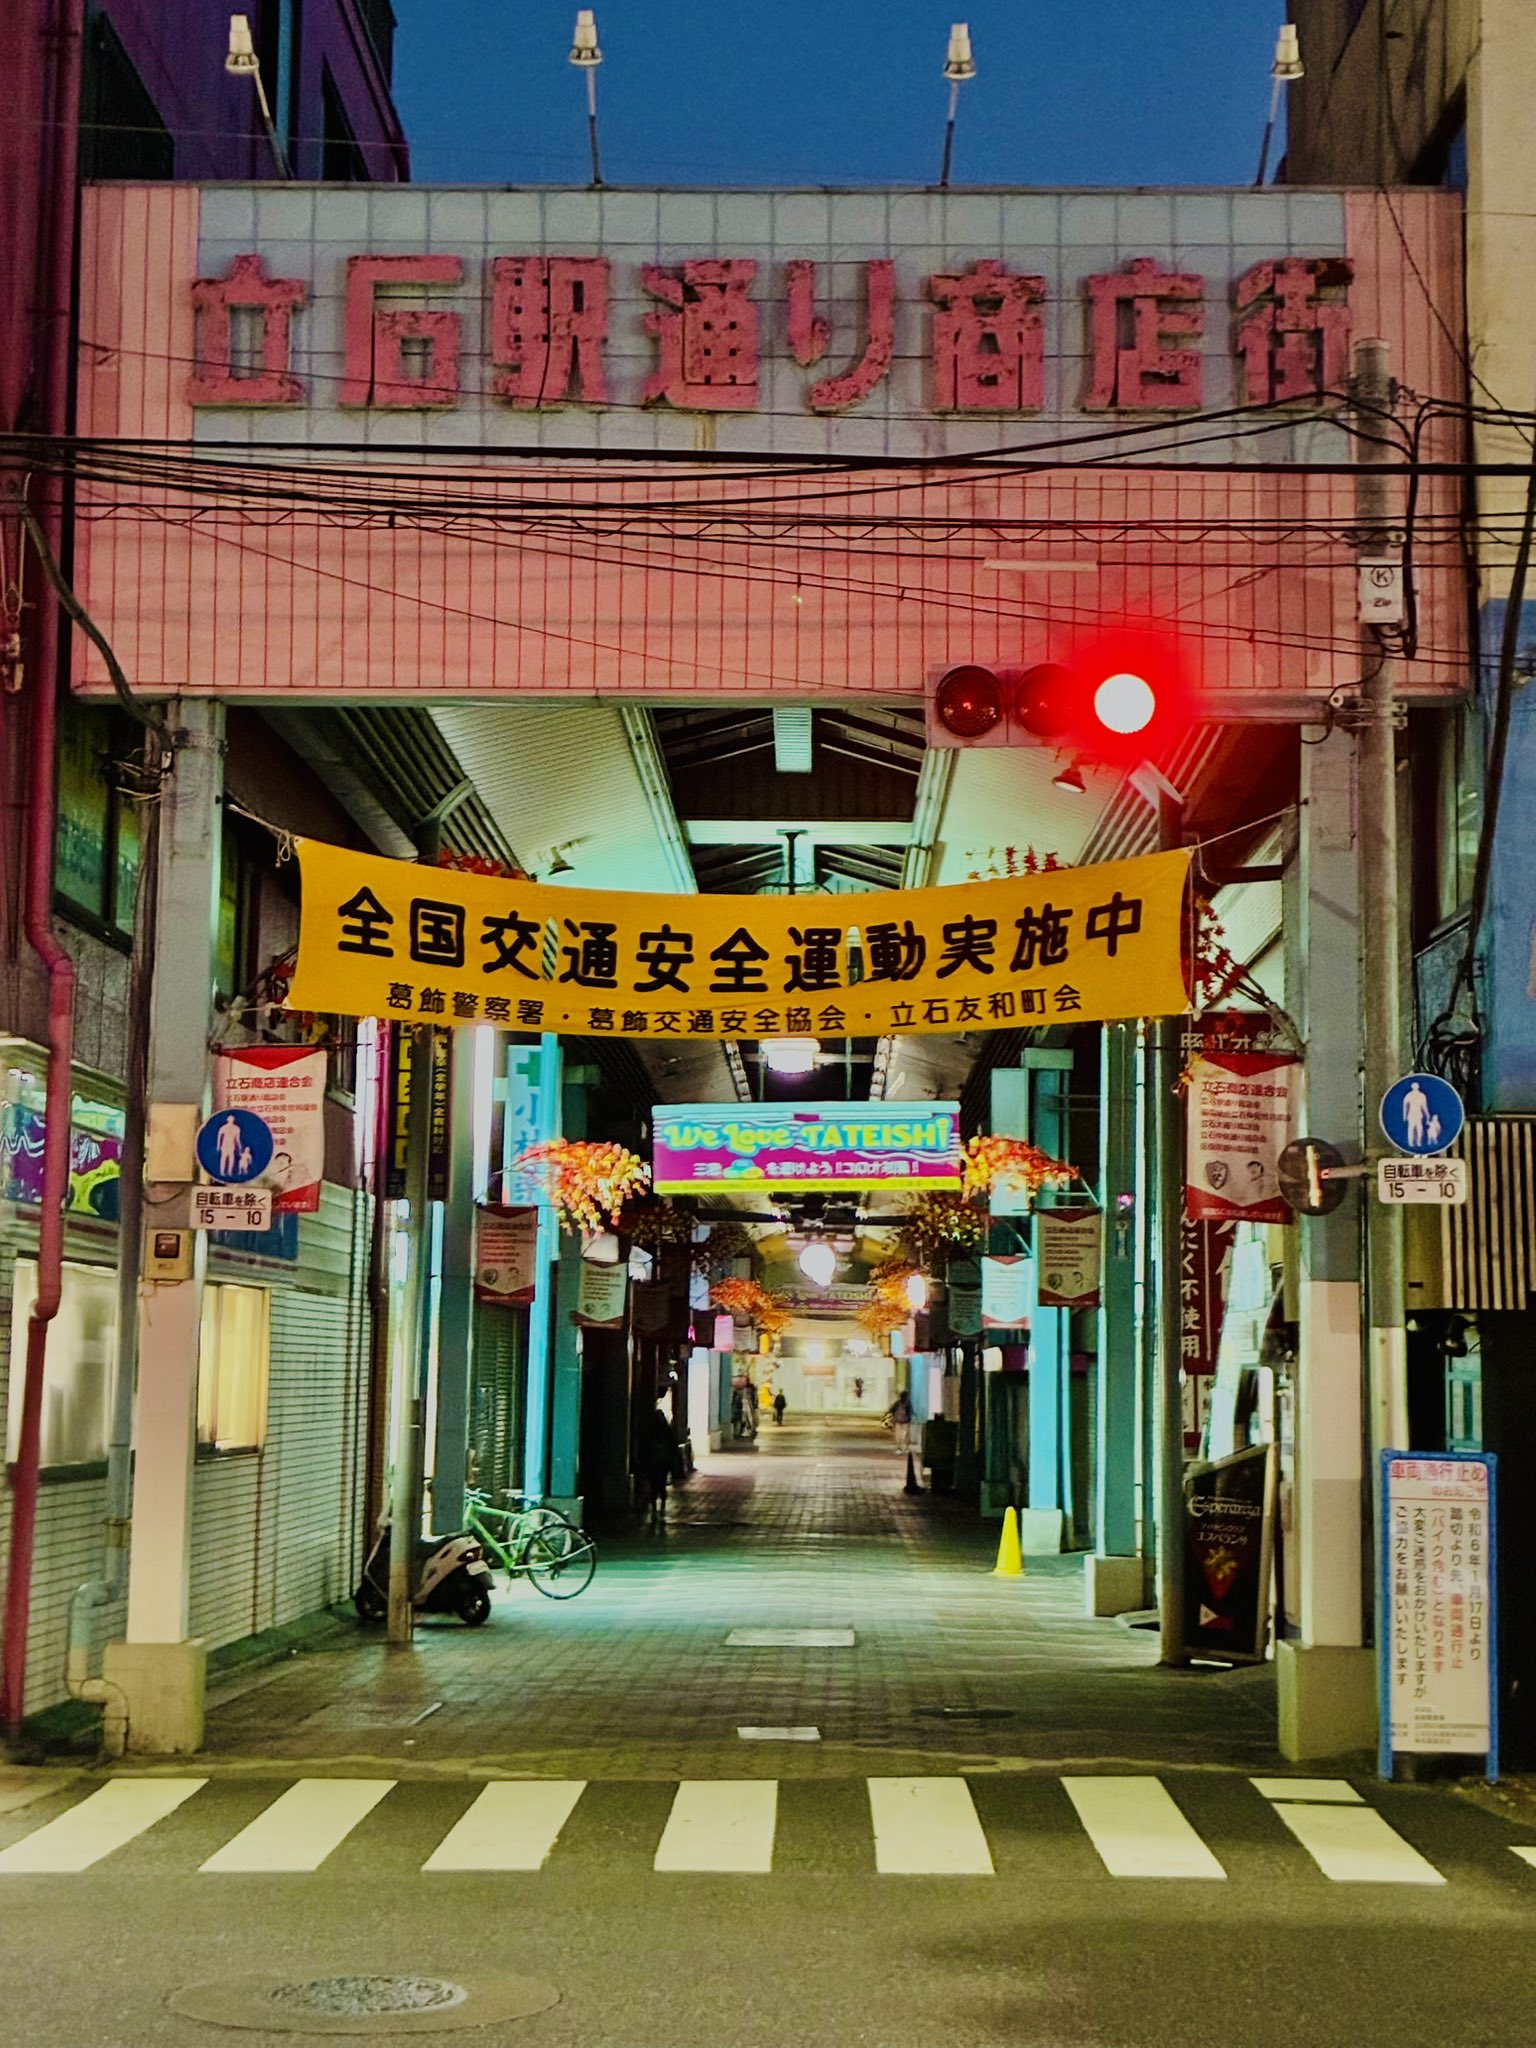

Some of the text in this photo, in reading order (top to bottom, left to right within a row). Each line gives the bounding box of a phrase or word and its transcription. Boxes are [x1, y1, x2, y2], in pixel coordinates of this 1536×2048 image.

[189, 254, 1354, 413] 立石駅通り商店街
[337, 886, 1143, 994] 全国交通安全運動実施中
[225, 1076, 313, 1090] 立石商店連合会
[663, 1124, 723, 1148] We
[722, 1122, 793, 1154] Love
[1383, 1164, 1460, 1181] 自転車を除く
[195, 1191, 268, 1207] 自転車を除く
[1388, 1182, 1406, 1199] 15
[1438, 1183, 1456, 1199] 10
[199, 1209, 215, 1225] 15
[246, 1210, 262, 1226] 10
[1390, 1461, 1487, 1482] 車両通行止め
